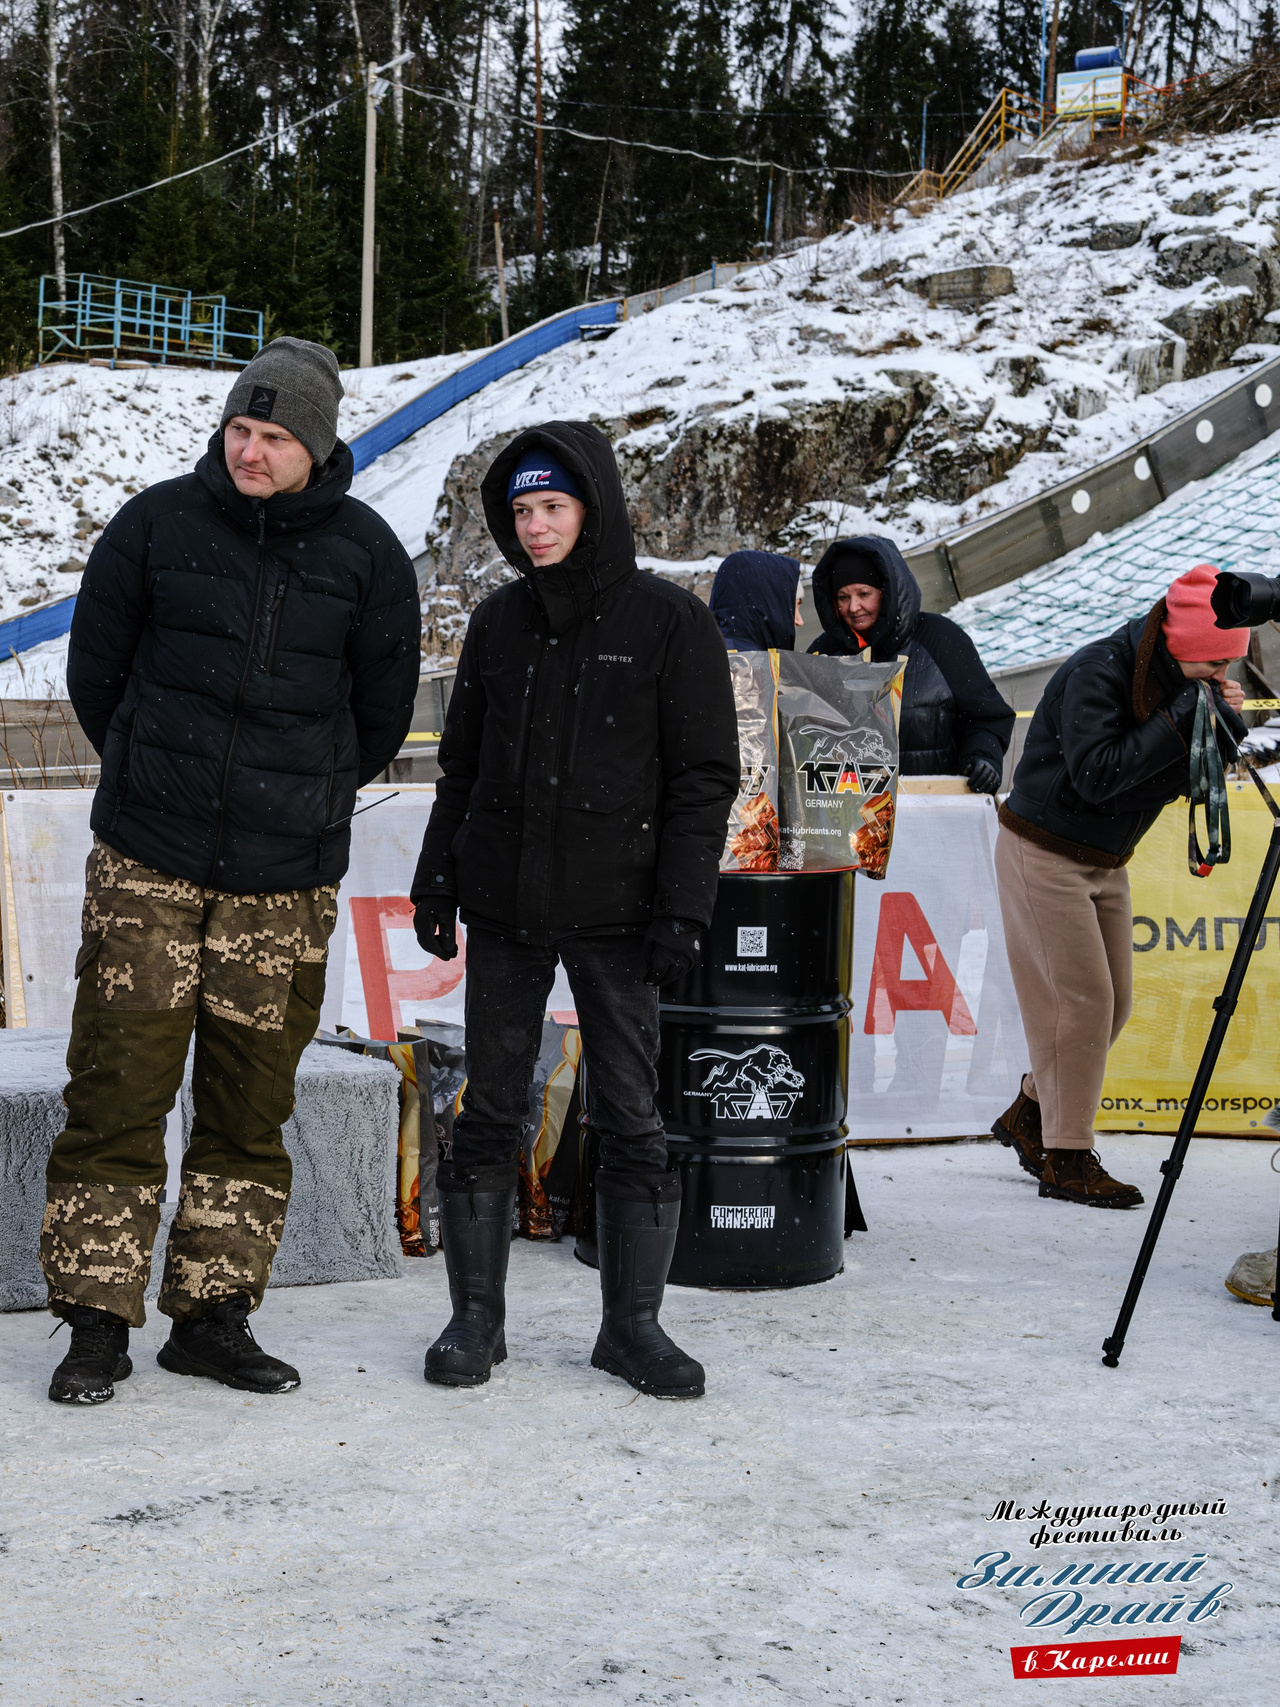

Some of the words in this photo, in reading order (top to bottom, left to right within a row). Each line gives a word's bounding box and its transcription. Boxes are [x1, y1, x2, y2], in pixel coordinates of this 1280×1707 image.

[598, 654, 634, 664] GORE-TEX
[804, 798, 845, 809] GERMANY
[1132, 915, 1280, 953] ОМПЛ
[724, 962, 779, 974] www.kat-lubricants.org
[682, 1089, 713, 1098] GERMANY
[712, 1206, 775, 1219] COMMERCIAL
[711, 1217, 775, 1229] TRANSPORT
